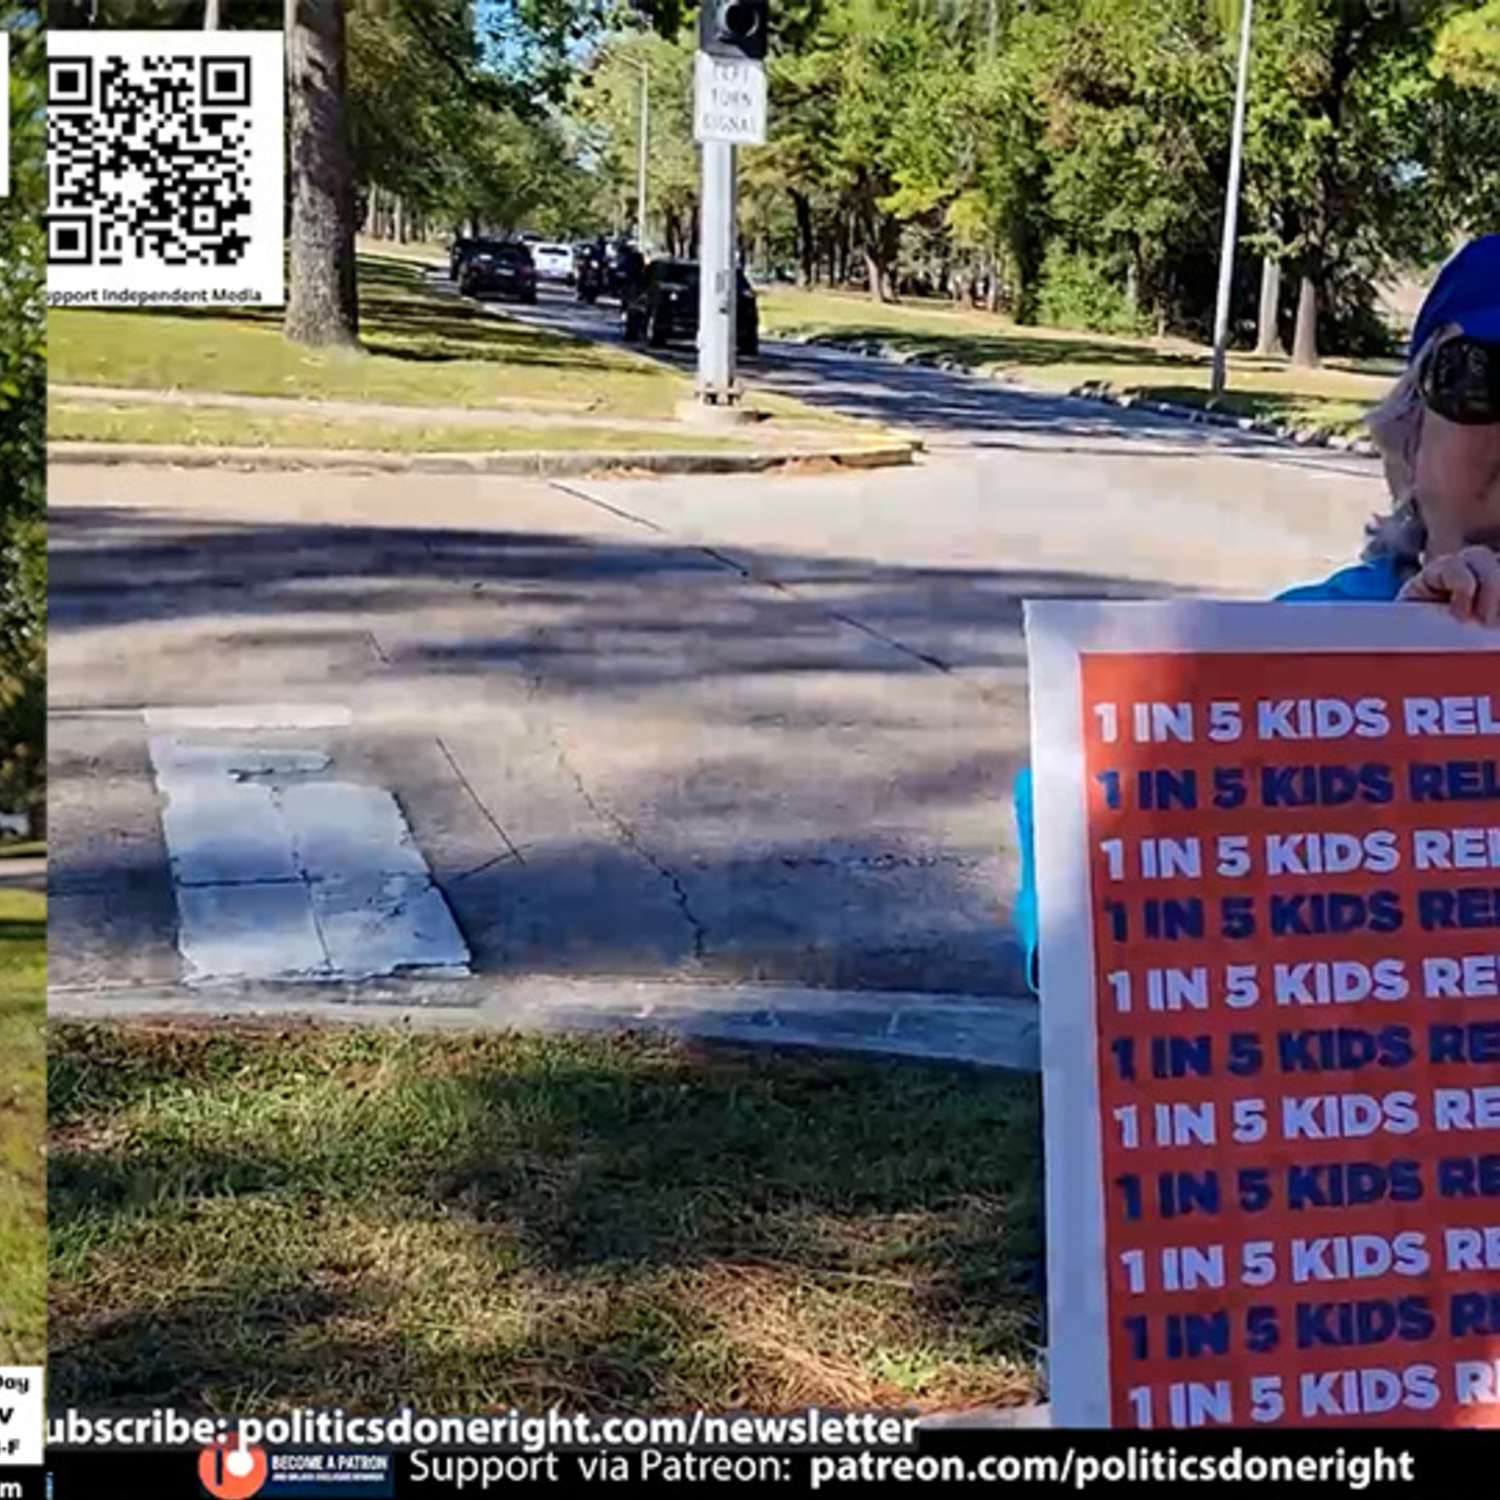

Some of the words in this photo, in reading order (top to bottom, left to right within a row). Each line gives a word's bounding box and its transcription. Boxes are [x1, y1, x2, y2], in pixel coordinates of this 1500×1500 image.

[1094, 702, 1118, 742] 1
[1134, 702, 1193, 742] IN
[1209, 701, 1241, 741] 5
[1257, 697, 1390, 740] KIDS
[1405, 696, 1500, 736] REL
[1097, 770, 1120, 809] 1
[1139, 769, 1196, 809] IN
[1213, 768, 1247, 808] 5
[1261, 763, 1393, 807] KIDS
[1101, 840, 1124, 880] 1
[1141, 838, 1200, 878] IN
[1217, 836, 1250, 877] 5
[1266, 831, 1399, 875] KIDS
[1105, 901, 1127, 942] 1
[1144, 899, 1204, 939] IN
[1221, 897, 1256, 938] 5
[1270, 890, 1402, 936] KIDS
[1418, 887, 1500, 930] RE
[1109, 972, 1131, 1013] 1
[1149, 968, 1207, 1011] IN
[1227, 966, 1259, 1009] 5
[1275, 959, 1408, 1006] KIDS
[1112, 1038, 1136, 1080] 1
[1151, 1035, 1211, 1078] IN
[1227, 1033, 1262, 1075] 5
[1278, 1025, 1413, 1073] KIDS
[1114, 1106, 1138, 1148] 1
[1155, 1102, 1216, 1146] IN
[1233, 1099, 1267, 1142] 5
[1282, 1092, 1419, 1140] KIDS
[1116, 1174, 1141, 1219] 1
[1158, 1171, 1220, 1217] IN
[1238, 1168, 1272, 1213] 5
[1287, 1160, 1423, 1210] KIDS
[1121, 1250, 1145, 1292] 1
[1162, 1245, 1224, 1290] IN
[1241, 1241, 1276, 1284] 5
[1292, 1232, 1430, 1282] KIDS
[1123, 1315, 1148, 1360] 1
[1166, 1311, 1228, 1358] IN
[1247, 1307, 1279, 1352] 5
[1295, 1296, 1435, 1348] KIDS
[1129, 1386, 1152, 1428] 1
[1170, 1383, 1232, 1427] IN
[1251, 1377, 1284, 1422] 5
[1300, 1365, 1440, 1416] KIDS
[1455, 1361, 1500, 1404] R
